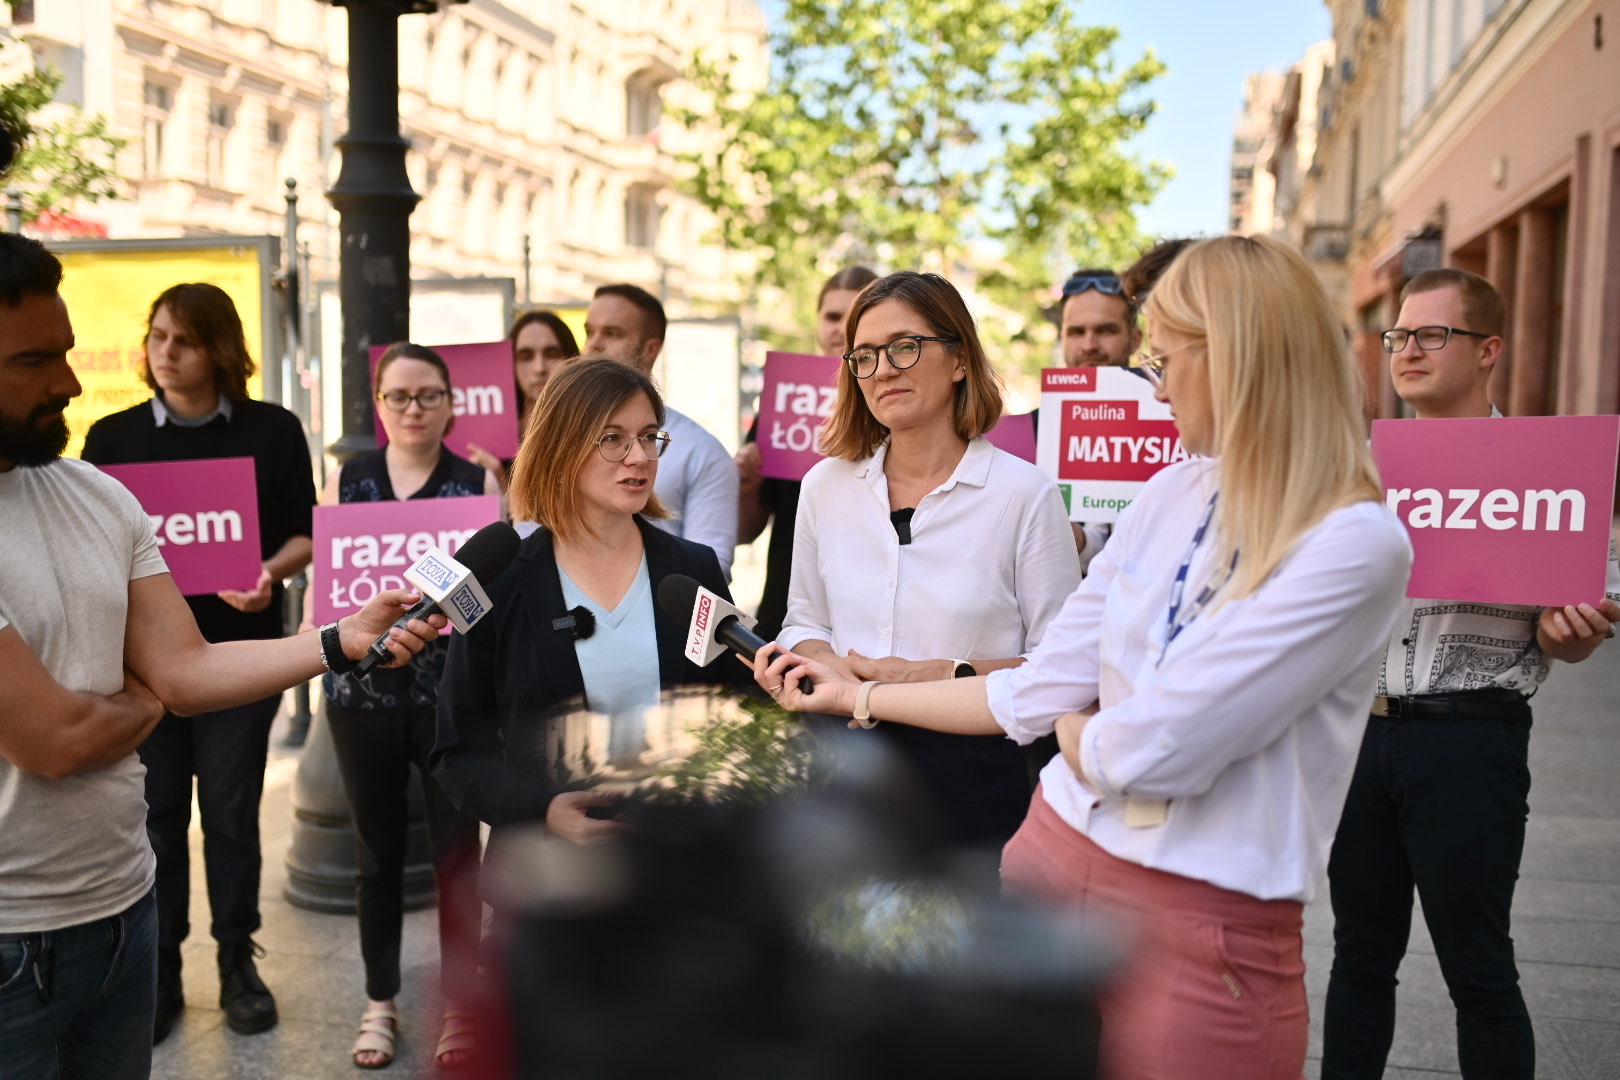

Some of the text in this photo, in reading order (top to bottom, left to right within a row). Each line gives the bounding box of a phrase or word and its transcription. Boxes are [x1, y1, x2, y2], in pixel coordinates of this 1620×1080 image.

[1046, 373, 1088, 385] LEWICA
[773, 382, 839, 418] raz
[1072, 403, 1126, 420] Paulina
[1067, 435, 1199, 464] MATYSIA
[1082, 495, 1132, 513] Europ
[1386, 487, 1586, 532] razem
[149, 509, 243, 547] zem
[420, 559, 447, 583] TOYA
[456, 589, 475, 616] TOYA
[691, 596, 710, 655] TVP INFO
